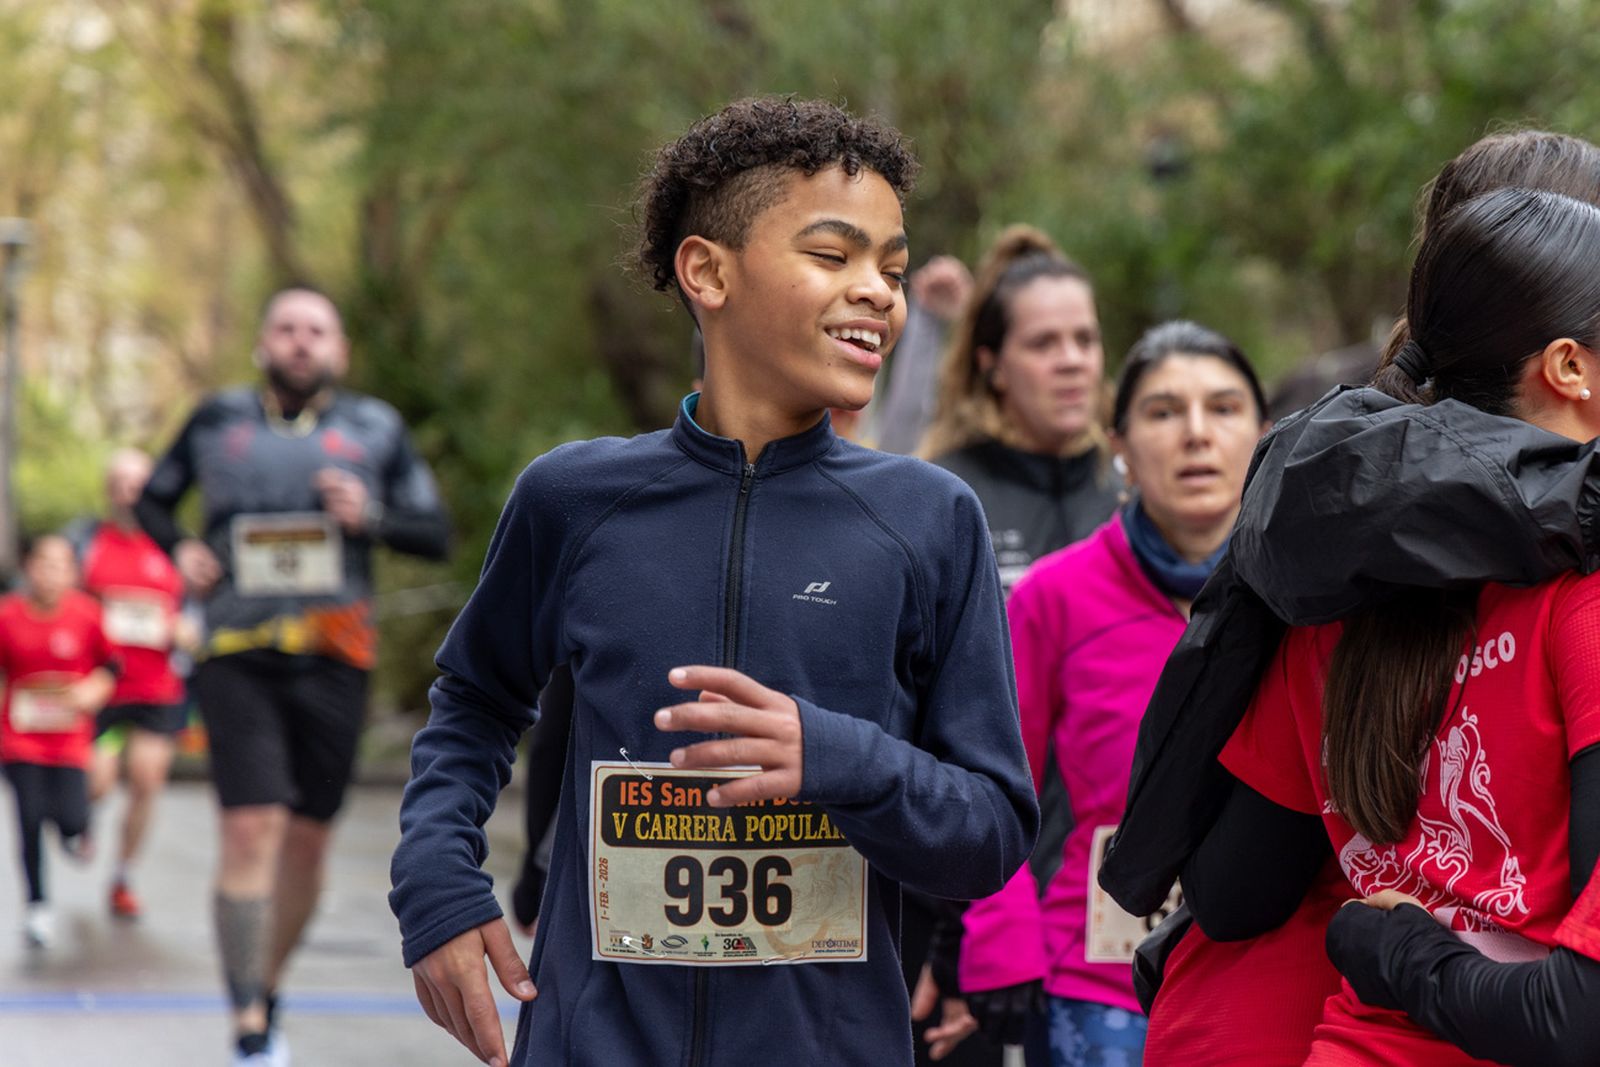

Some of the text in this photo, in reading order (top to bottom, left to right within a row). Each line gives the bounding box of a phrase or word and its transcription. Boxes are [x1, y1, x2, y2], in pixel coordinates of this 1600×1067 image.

[1454, 631, 1516, 685] OSCO
[620, 782, 653, 806] IES
[660, 782, 702, 806] San
[612, 812, 628, 839] V
[634, 812, 737, 842] CARRERA
[598, 856, 609, 882] 2026
[600, 890, 610, 909] FEB.
[663, 854, 793, 928] 936
